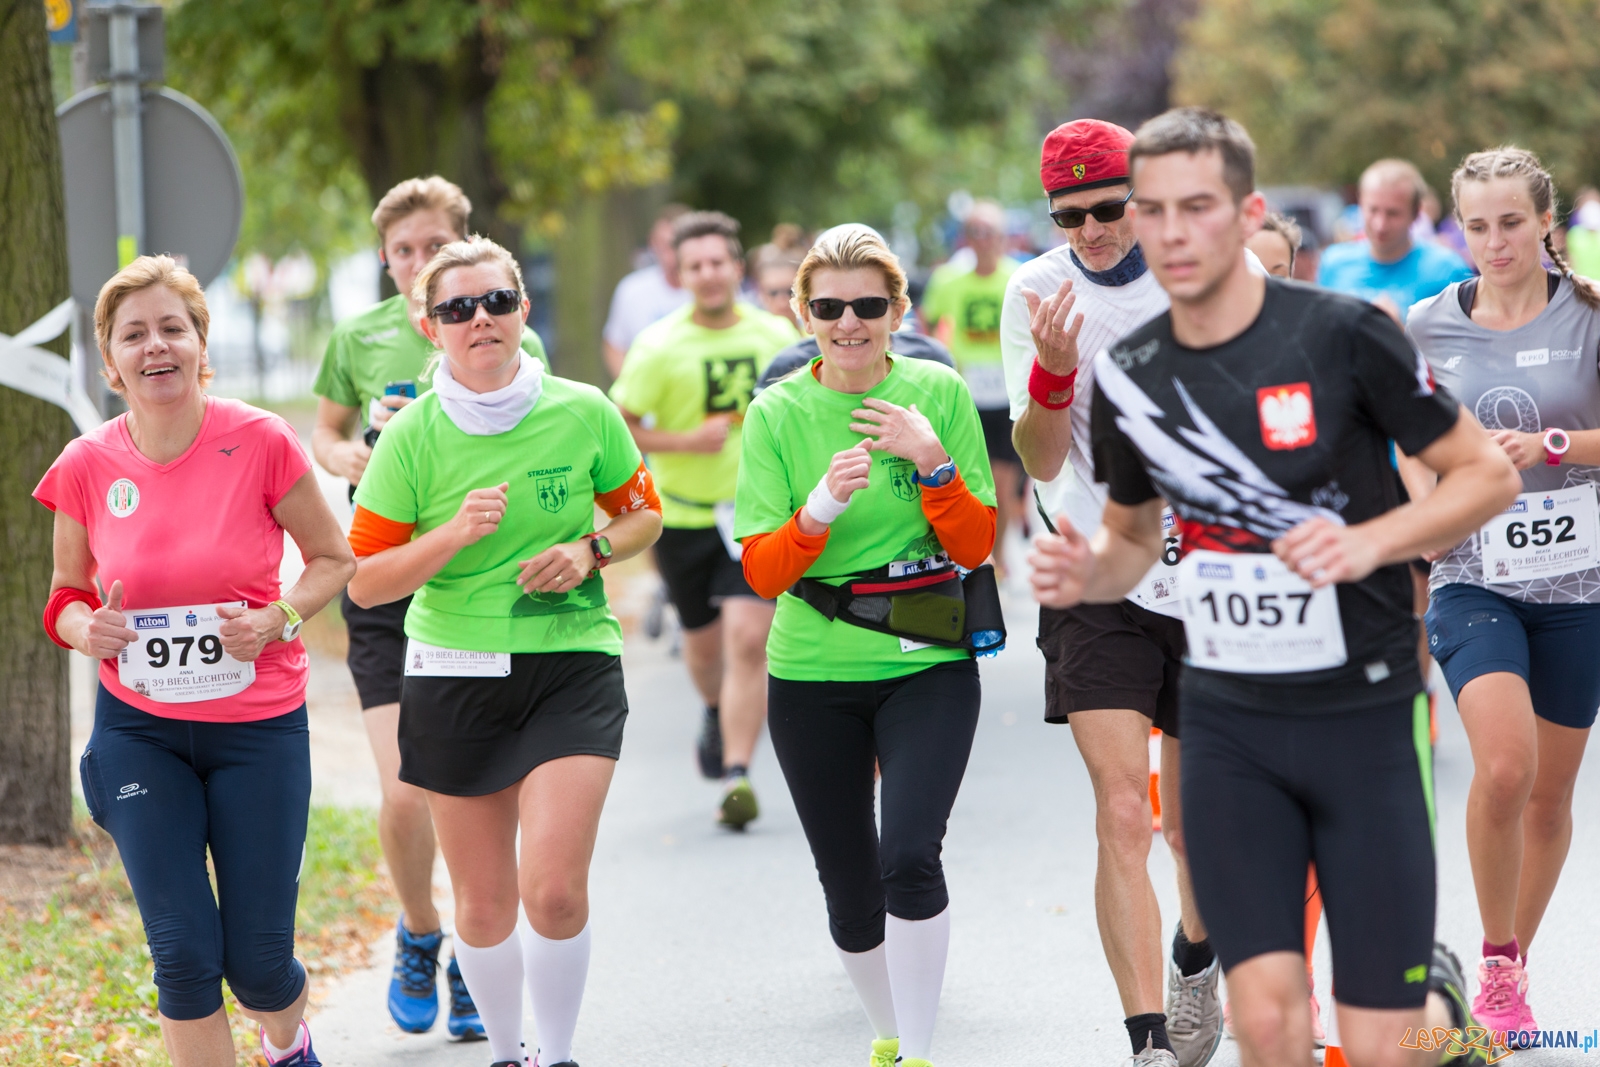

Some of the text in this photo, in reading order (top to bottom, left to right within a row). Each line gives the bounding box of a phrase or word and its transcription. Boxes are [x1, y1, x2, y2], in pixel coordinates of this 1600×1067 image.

[1506, 515, 1577, 549] 652
[1511, 558, 1523, 567] 39
[1525, 554, 1547, 566] BIEG
[1200, 590, 1313, 627] 1057
[145, 634, 224, 669] 979
[425, 651, 434, 660] 39
[436, 651, 453, 660] BIEG
[152, 679, 164, 687] 39
[167, 675, 190, 687] BIEG
[192, 669, 242, 685] LECHITÓW
